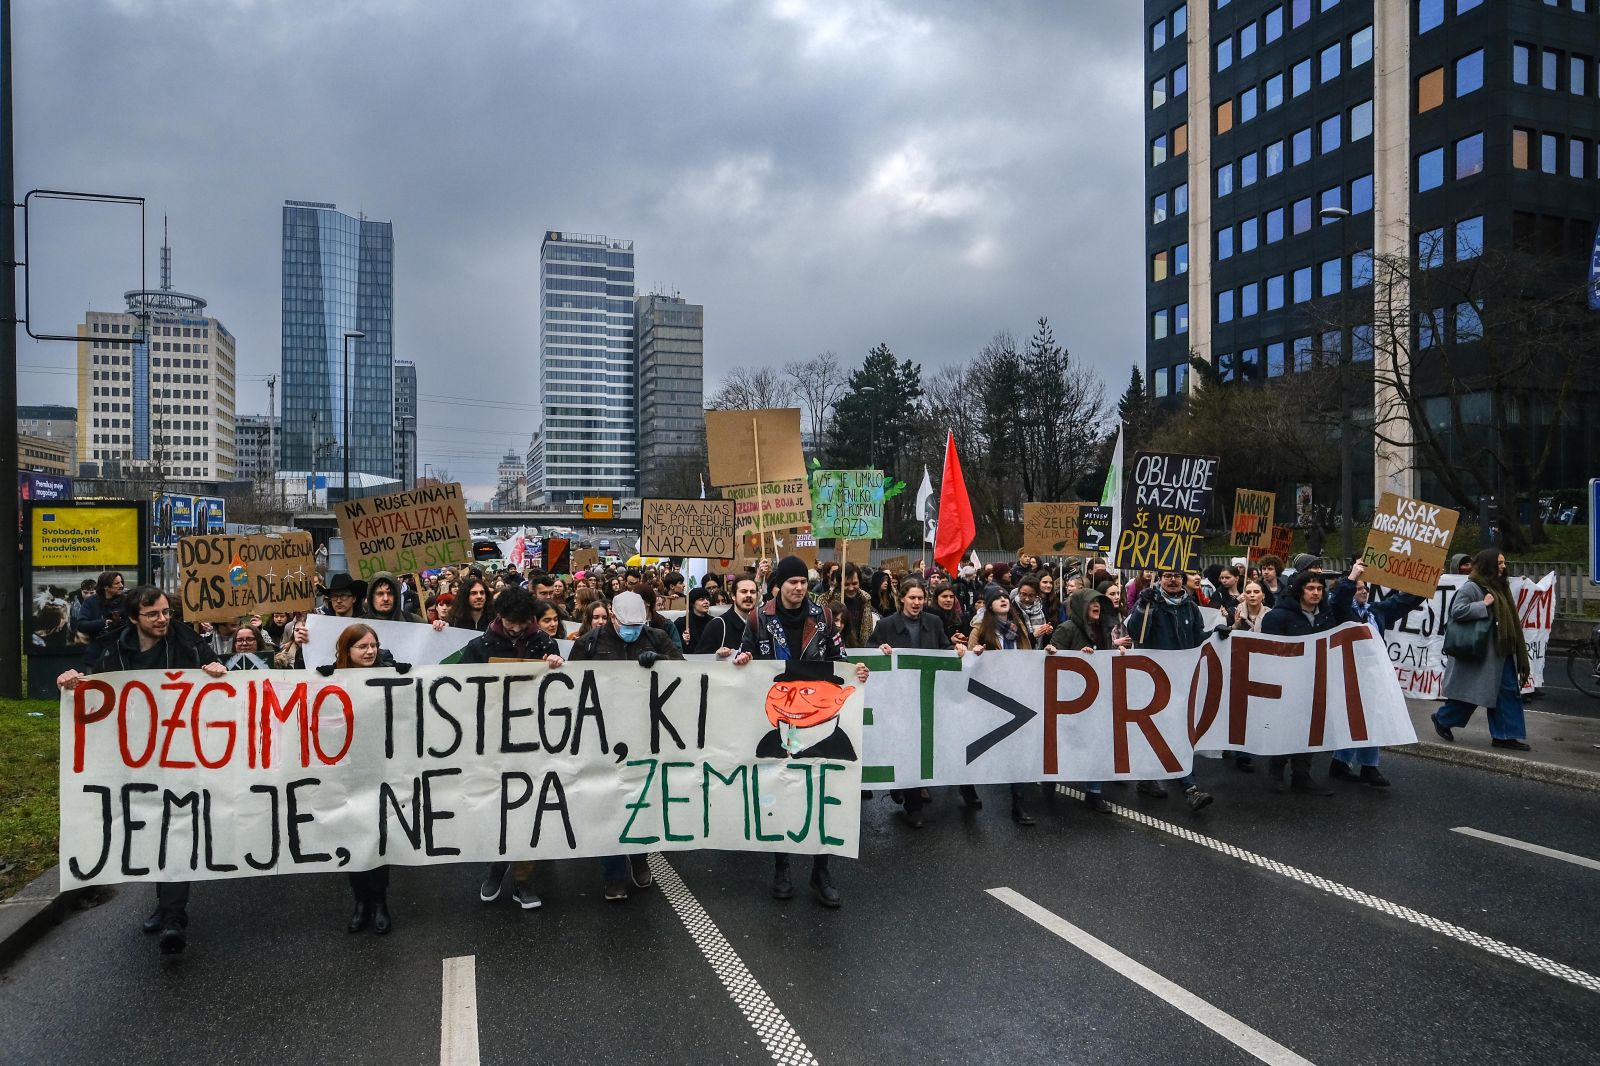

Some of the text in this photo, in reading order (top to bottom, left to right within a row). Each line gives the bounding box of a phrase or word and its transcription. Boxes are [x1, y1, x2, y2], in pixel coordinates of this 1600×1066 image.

[816, 472, 883, 489] VSE JE UMRLO
[1135, 456, 1217, 491] OBLJUBE
[344, 485, 457, 519] NA RUŠEVINAH
[650, 503, 698, 514] NARAVA
[703, 504, 730, 516] NAS
[775, 498, 795, 509] BOJA
[796, 498, 804, 506] JE
[828, 489, 834, 503] V
[860, 490, 871, 503] KO
[1136, 485, 1206, 515] RAZNE,
[1236, 492, 1270, 518] NARAVO
[352, 505, 459, 540] KAPITALIZMA
[647, 514, 731, 526] NE POTREBUJE
[816, 503, 832, 518] STE
[836, 503, 846, 518] MI
[1133, 507, 1200, 534] ŠE VEDNO
[1396, 498, 1440, 526] VSAK
[42, 527, 100, 536] Svoboda, mir
[51, 536, 101, 544] energetska
[360, 524, 460, 556] BOMO ZGRADILI
[643, 525, 734, 538] MI POTREBUJEMO
[833, 518, 869, 537] GOZD
[1373, 512, 1450, 547] ORGANIZEM
[181, 538, 315, 568] DOST GOVORIČENJA
[423, 540, 468, 567] SVET
[646, 535, 725, 555] NARAVO
[1116, 530, 1204, 573] PRAZNE
[1389, 536, 1412, 557] ZA
[184, 570, 316, 612] ČAS JE ZA DEJANJA
[1043, 625, 1373, 775] PROFIT
[73, 669, 709, 773] POŽGIMO TISTEGA, KI
[69, 759, 845, 880] JEMLJE, NE PA ZEMLJE
